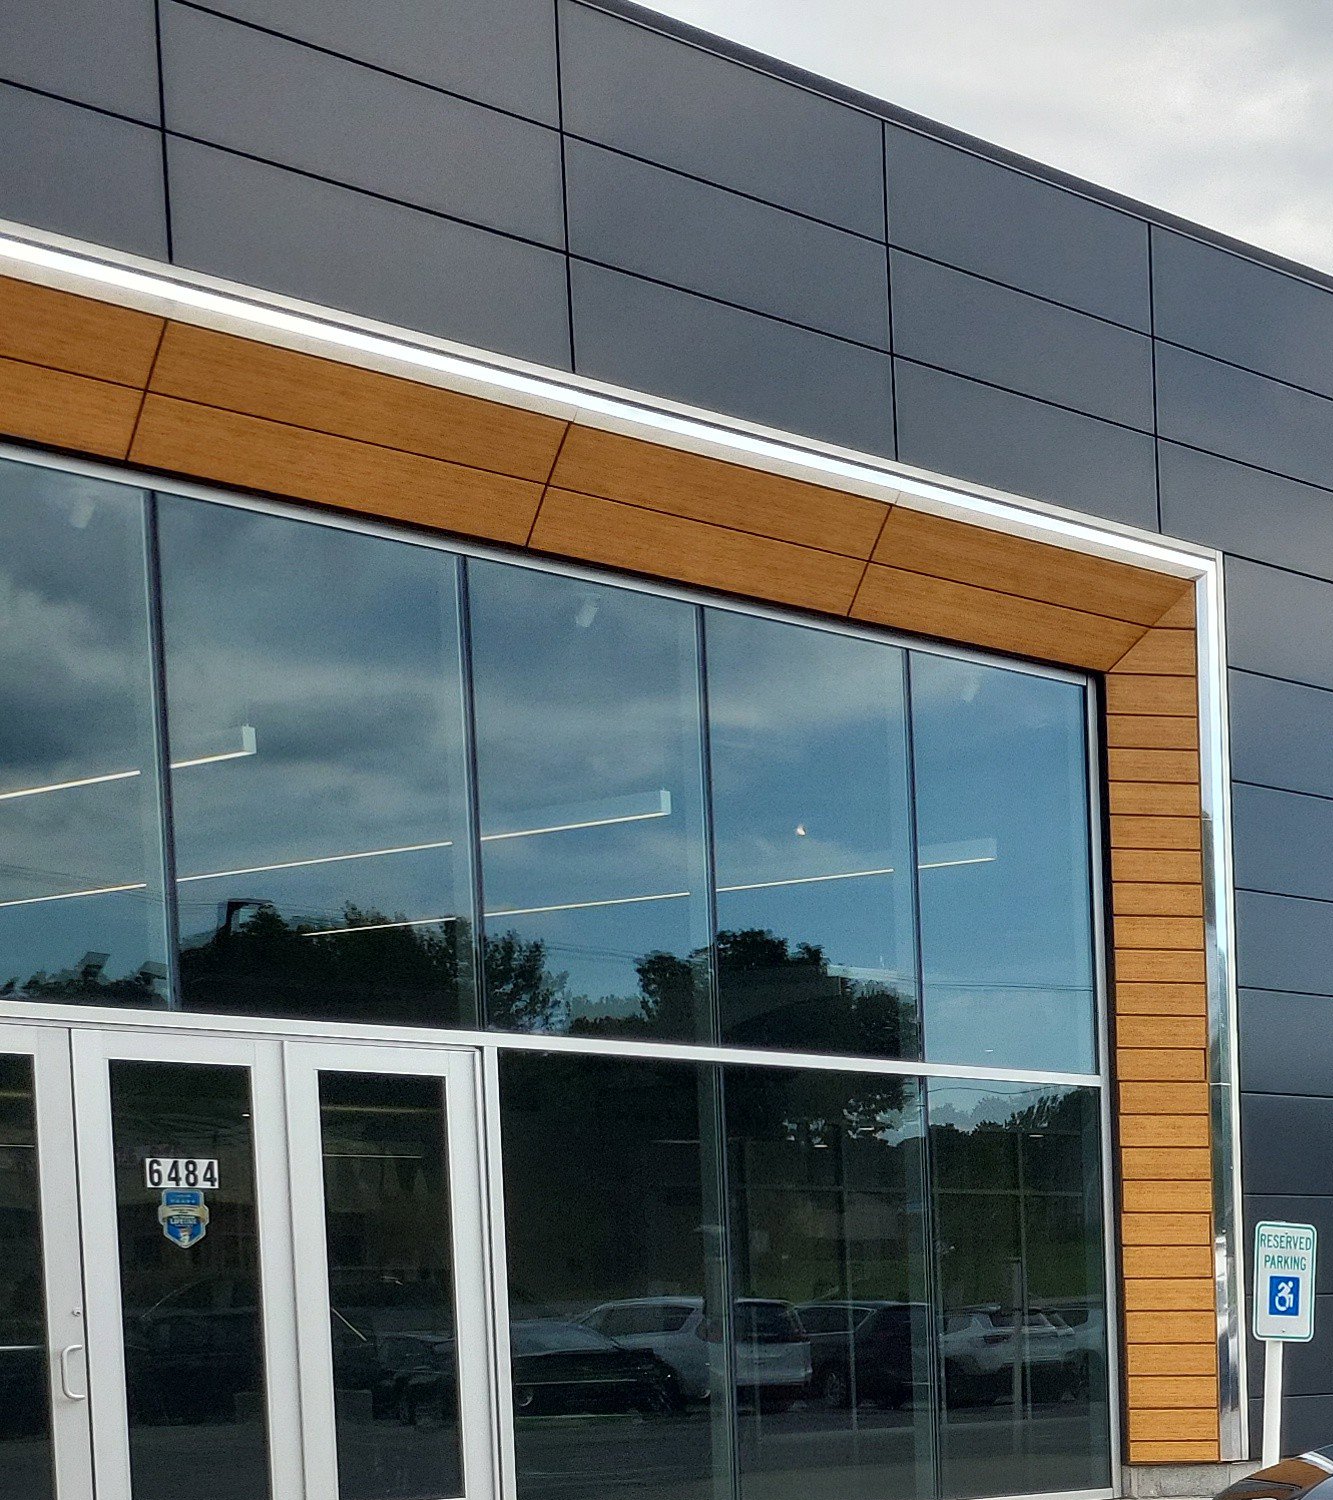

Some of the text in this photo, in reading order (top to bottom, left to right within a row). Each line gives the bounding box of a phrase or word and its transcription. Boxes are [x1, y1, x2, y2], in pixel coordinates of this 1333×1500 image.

[148, 1159, 217, 1187] 6484
[1260, 1233, 1312, 1251] RESERVED
[1264, 1255, 1307, 1271] PARKING
